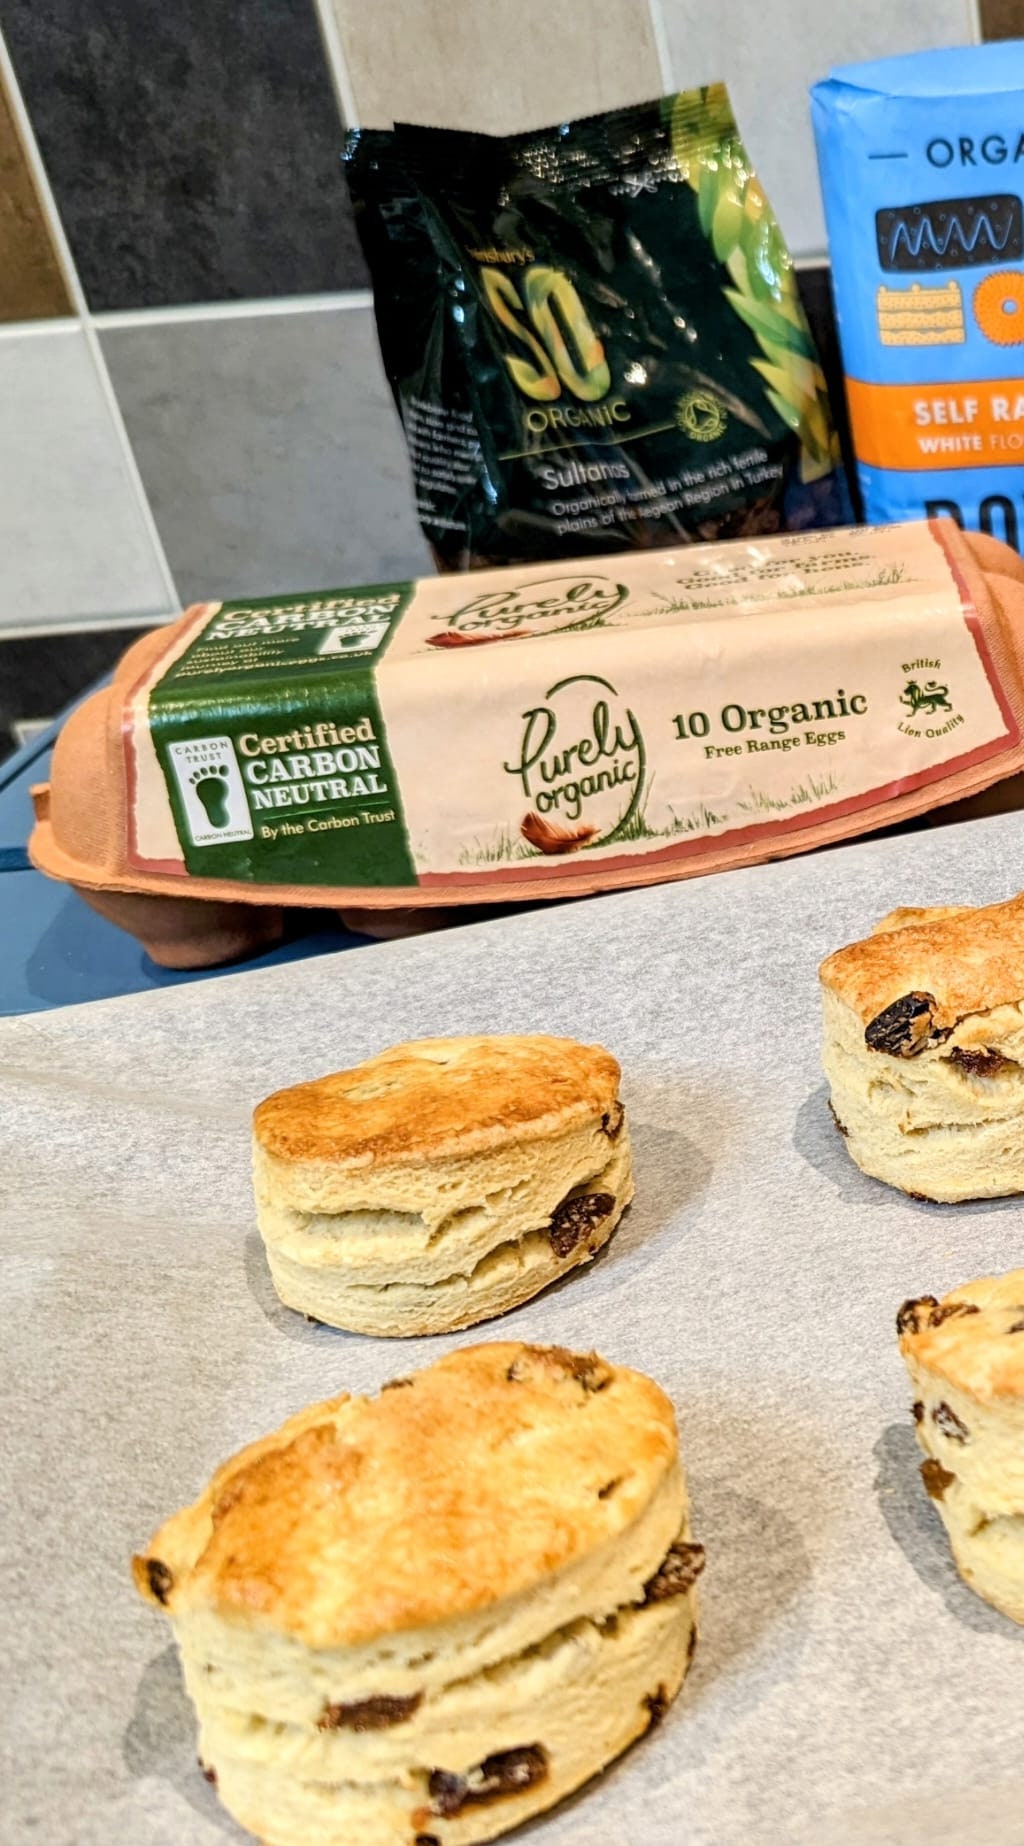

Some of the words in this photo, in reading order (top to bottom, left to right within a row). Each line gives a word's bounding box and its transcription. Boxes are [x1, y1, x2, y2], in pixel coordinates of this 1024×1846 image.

[481, 266, 611, 401] SO
[526, 400, 631, 433] ORGANIC
[914, 398, 979, 427] SELF
[917, 434, 983, 454] WHITE
[668, 477, 683, 493] in
[683, 468, 705, 488] the
[708, 459, 733, 480] rich
[557, 516, 599, 538] plains
[684, 480, 729, 506] Region
[732, 475, 745, 492] in
[744, 463, 783, 486] Turkey
[214, 603, 399, 632] CARBON
[222, 593, 401, 622] Certified
[430, 582, 629, 627] Purely
[457, 599, 611, 632] organic
[205, 613, 392, 642] NEUTRAL
[261, 636, 301, 647] more
[901, 656, 942, 674] British
[671, 711, 712, 741] 10
[721, 688, 869, 735] Organic
[897, 721, 922, 739] Lion
[925, 711, 966, 739] Quality
[175, 740, 229, 756] CARBON
[239, 717, 377, 758] Certified
[503, 700, 647, 798] Purely
[704, 742, 743, 760] Free
[746, 734, 801, 754] Range
[804, 728, 846, 747] Eggs
[185, 751, 223, 765] TRUST
[246, 745, 382, 786] CARBON
[252, 774, 389, 811] NEUTRAL
[535, 758, 637, 821] organic
[194, 832, 224, 843] CARBON
[261, 825, 280, 841] By
[281, 821, 304, 836] the
[307, 814, 360, 833] Carbon
[362, 808, 396, 824] Trust
